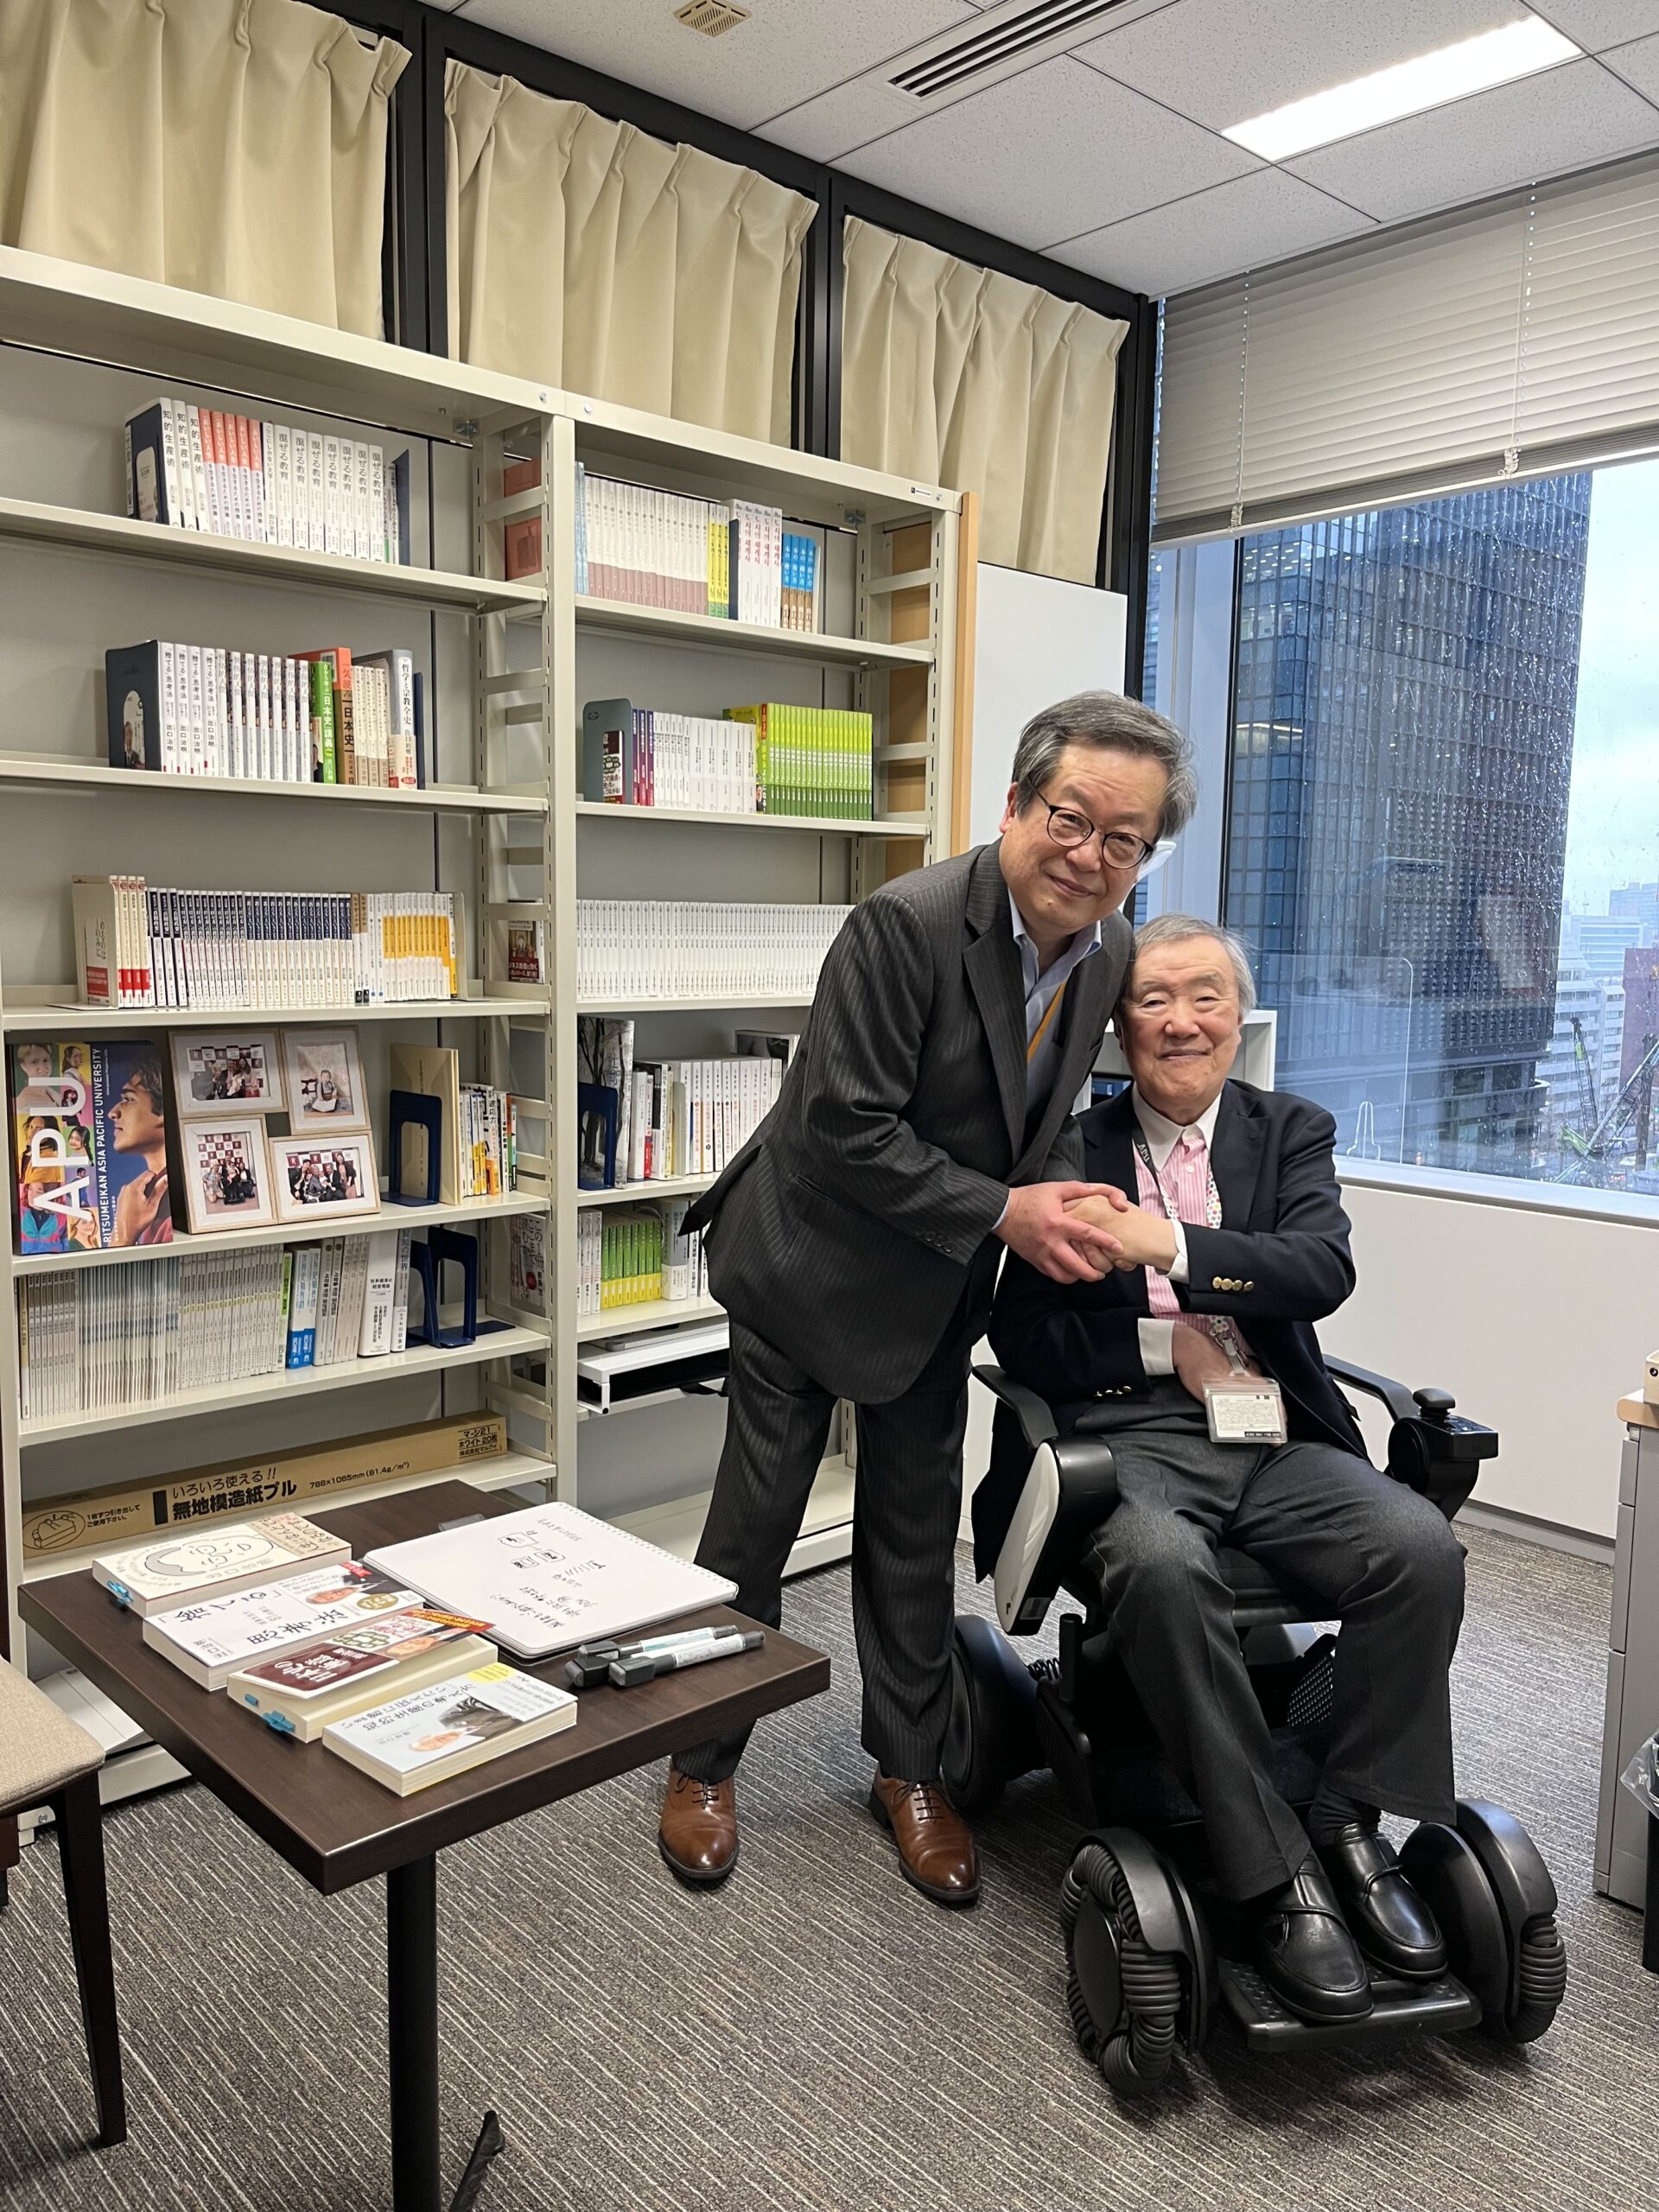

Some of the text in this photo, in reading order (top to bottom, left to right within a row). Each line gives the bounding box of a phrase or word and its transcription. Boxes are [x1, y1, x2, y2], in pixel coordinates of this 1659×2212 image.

[162, 410, 175, 467] 知的生産術
[177, 413, 190, 469] 知的生産術
[190, 418, 204, 474] 知的生産術
[278, 433, 289, 481] 混ぜる教育
[296, 437, 305, 485] 混ぜる教育
[311, 440, 321, 488] 混ぜる教育
[327, 443, 337, 490] 混ぜる教育
[342, 446, 353, 493] 混ぜる教育
[358, 449, 367, 496] 混ぜる教育
[372, 452, 382, 499] 混ぜる教育
[164, 647, 174, 699] 「捨てる」思考法
[178, 649, 187, 700] 「捨てる」思考法
[191, 651, 200, 702] 「捨てる」思考法
[206, 652, 215, 702] 「捨てる」思考法
[402, 664, 412, 726] 哲学と宗教全史
[193, 726, 201, 754] 出口治明
[207, 720, 215, 748] 出口治明
[344, 707, 354, 747] 日本史
[29, 1077, 92, 1222] APU
[92, 1047, 111, 1243] RITSUMEIKAN ASIA PACIFIC UNIVERSITY
[1137, 1143, 1150, 1162] APU
[459, 1434, 498, 1448] ホワイト 20枚
[460, 1444, 498, 1455] 株式会社マルアイ
[173, 1466, 276, 1500] いろいろ使える!!
[173, 1479, 297, 1521] 無地模造紙プル
[86, 1503, 141, 1521] 1枚ずつ引き出して
[86, 1516, 128, 1528] ご使用下さい。
[158, 1589, 283, 1624] 「捨てる」
[247, 1608, 349, 1645] 思考法
[193, 1637, 228, 1659] 出口治明
[273, 1660, 338, 1683] 日本史の
[361, 1683, 478, 1732] 知的生産の考え方
